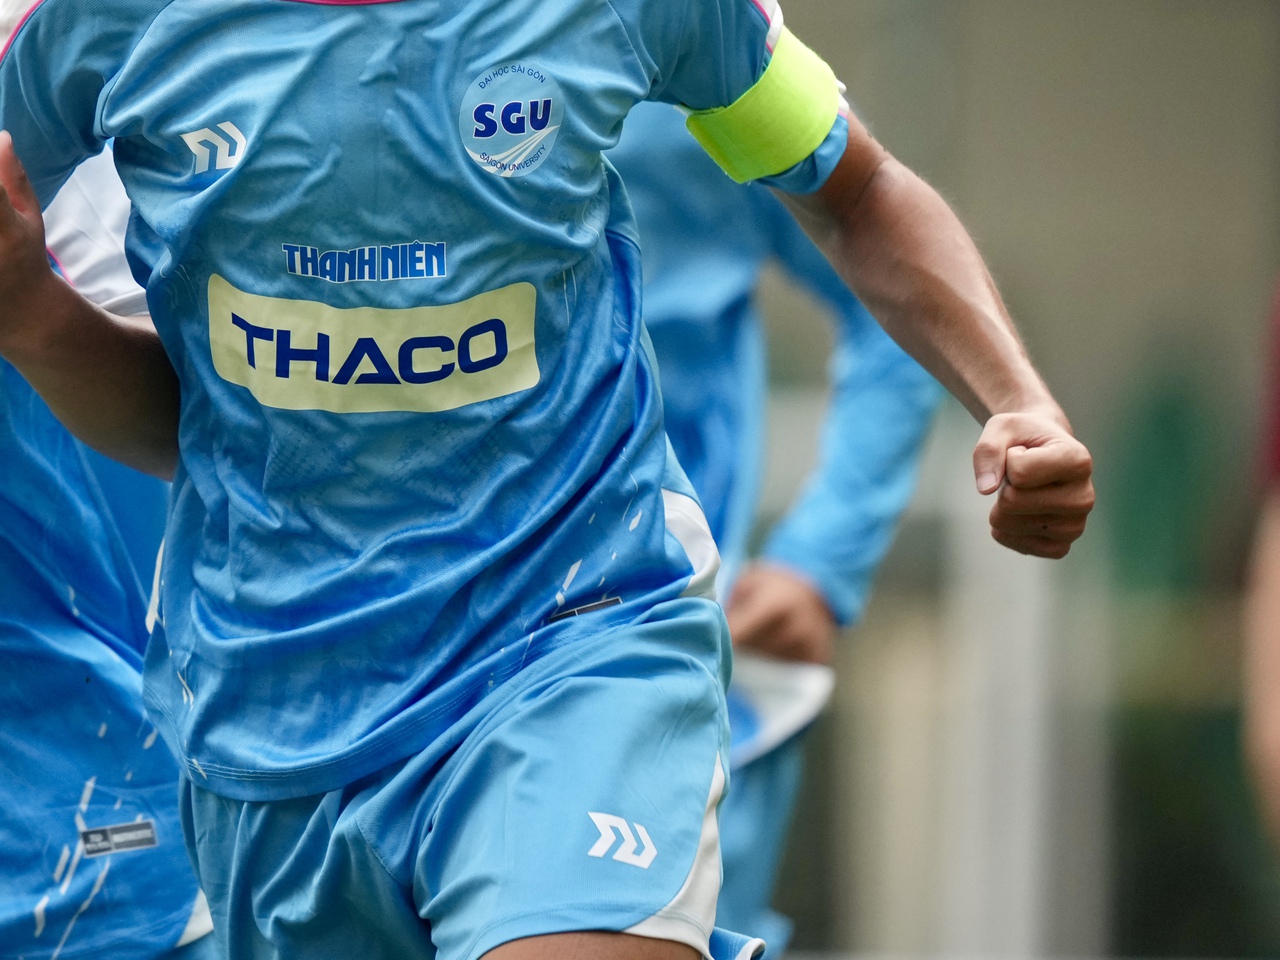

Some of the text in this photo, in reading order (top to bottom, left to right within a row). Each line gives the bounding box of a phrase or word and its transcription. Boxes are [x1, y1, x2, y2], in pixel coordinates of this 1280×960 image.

[478, 74, 493, 89] ĐẠI
[492, 66, 509, 78] HỌC
[473, 98, 552, 139] SGU
[479, 144, 546, 171] SAIGON UNIVERSITY
[282, 239, 447, 283] THANH NIÊN
[231, 312, 508, 385] THACO
